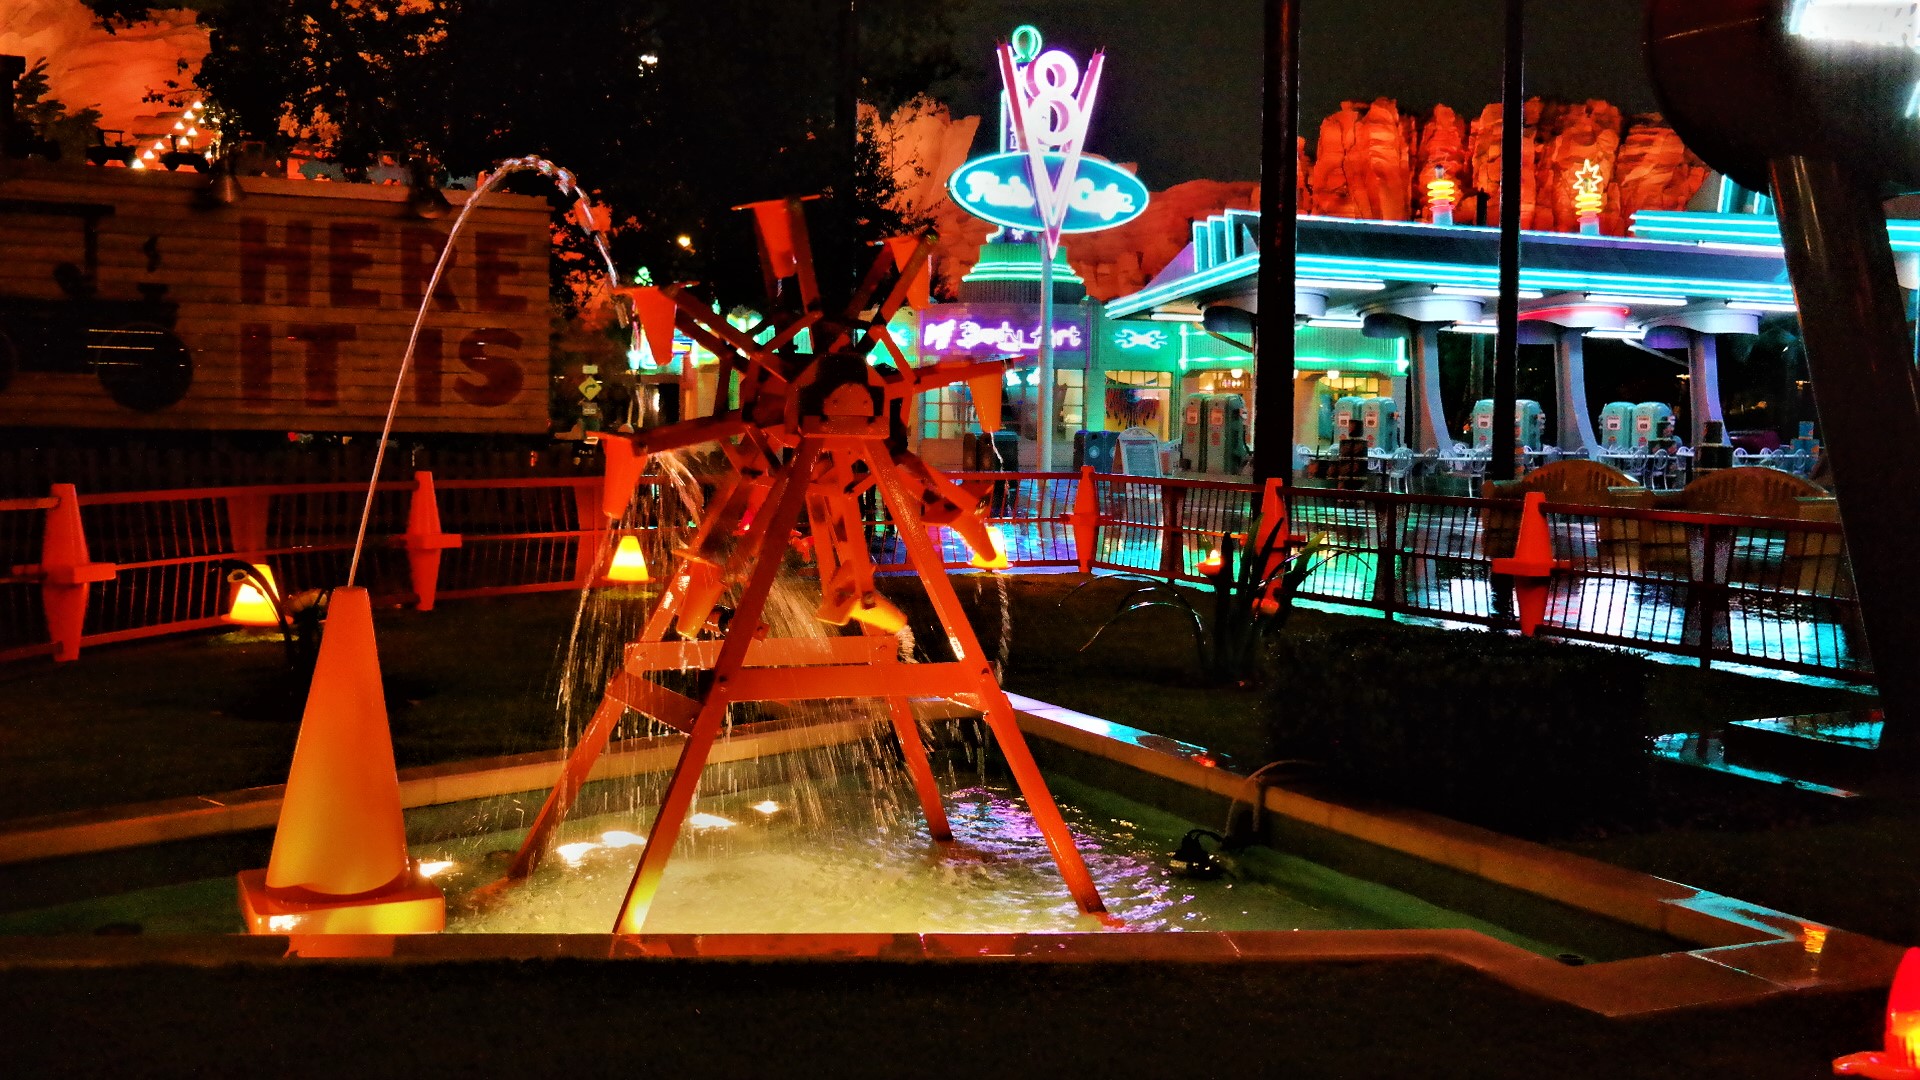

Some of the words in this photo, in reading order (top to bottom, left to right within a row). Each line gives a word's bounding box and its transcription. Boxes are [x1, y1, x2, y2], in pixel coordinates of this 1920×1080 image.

[240, 217, 528, 311] HERE
[240, 322, 357, 408] IT
[414, 327, 524, 407] IS
